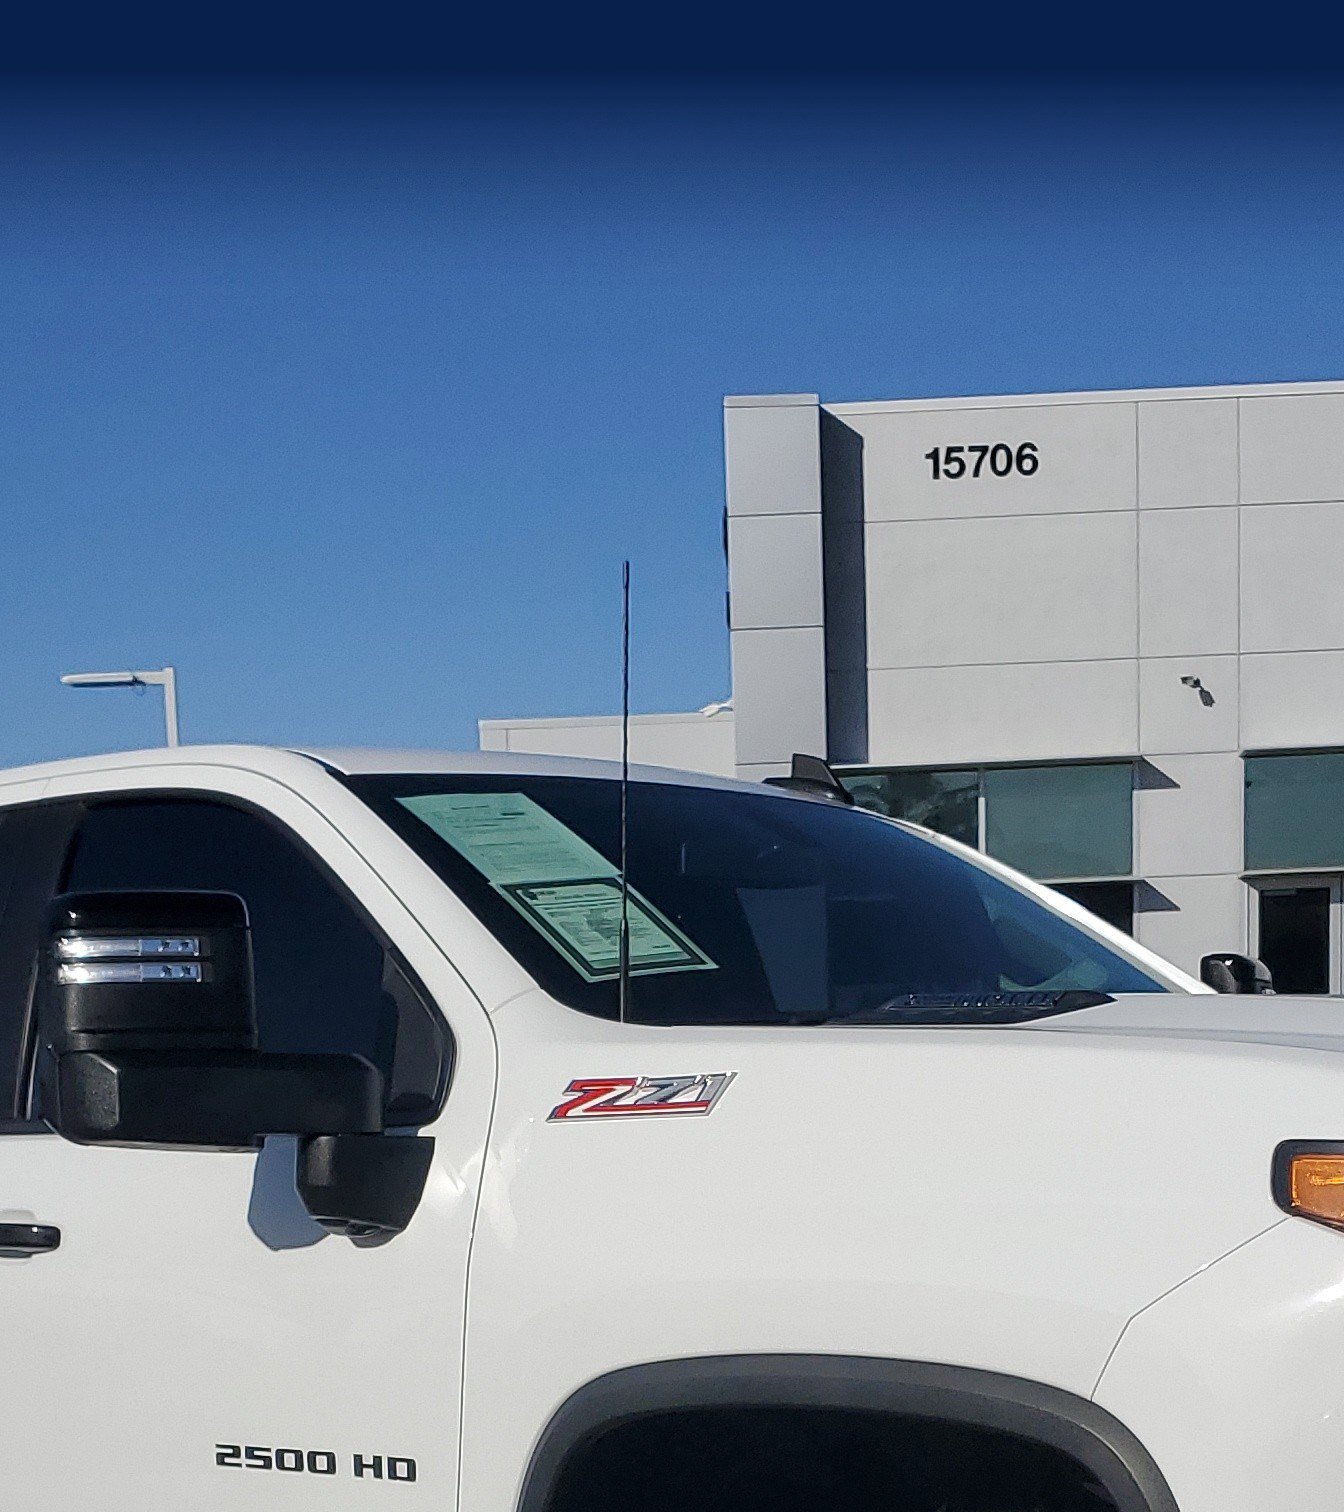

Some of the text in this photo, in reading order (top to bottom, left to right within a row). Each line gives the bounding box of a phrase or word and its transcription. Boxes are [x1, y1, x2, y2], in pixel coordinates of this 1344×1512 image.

[924, 442, 1039, 480] 15706
[545, 1072, 739, 1124] Z71
[215, 1443, 418, 1483] 2500 HD
